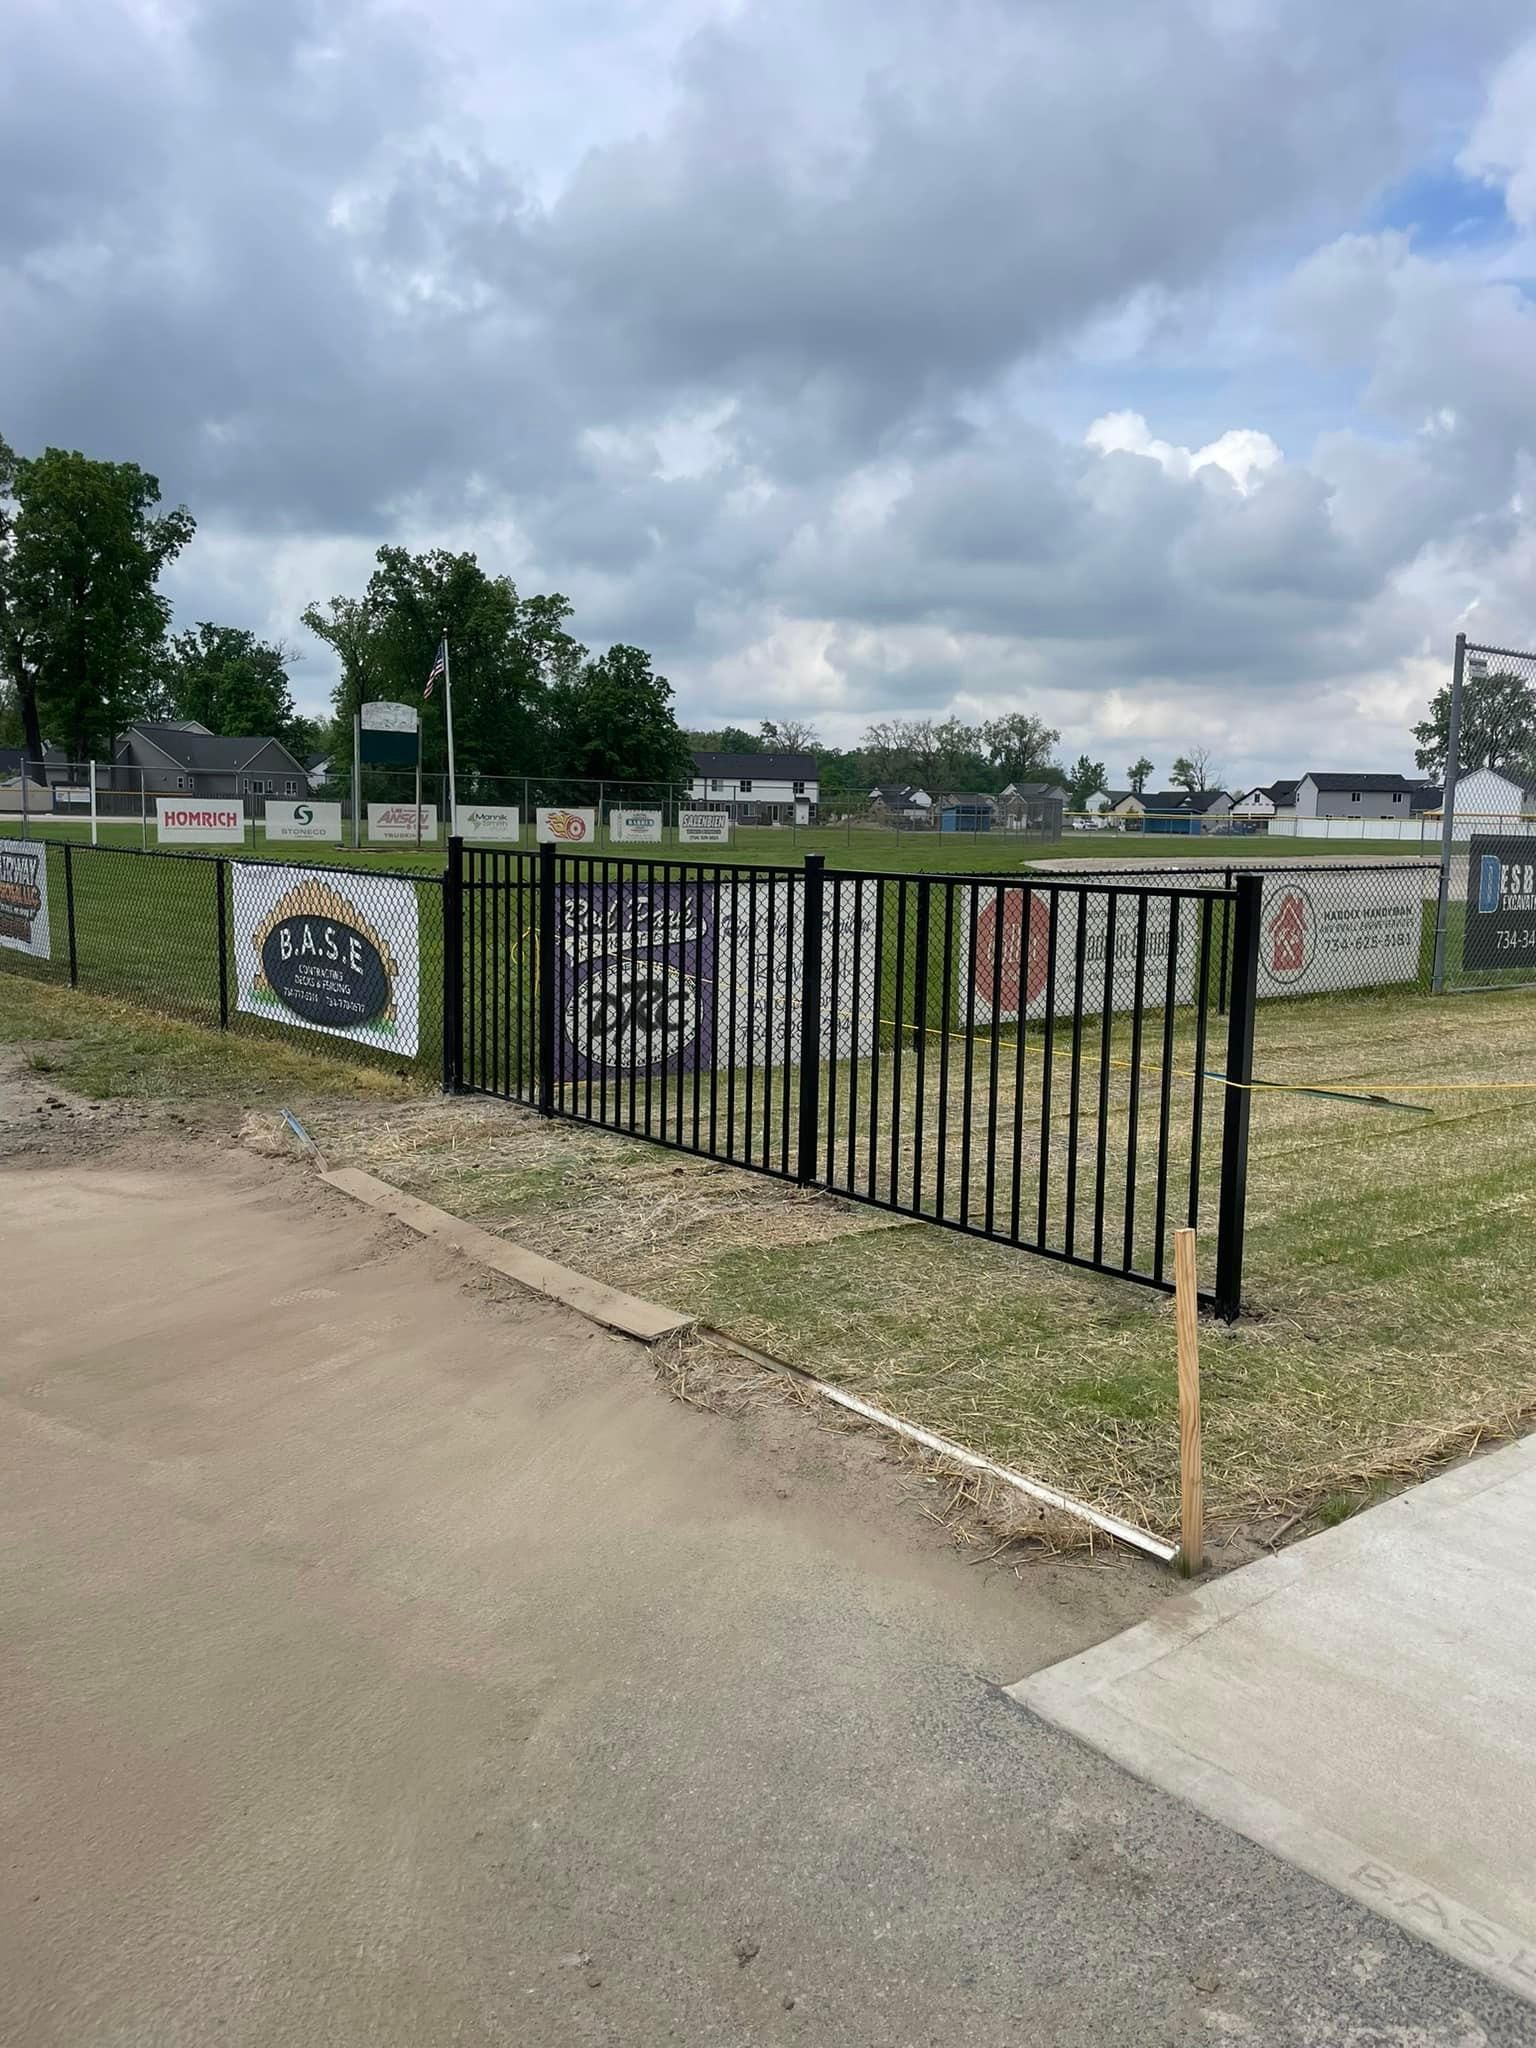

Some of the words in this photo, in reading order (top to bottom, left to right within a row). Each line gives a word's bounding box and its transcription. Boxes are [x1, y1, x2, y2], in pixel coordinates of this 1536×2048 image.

[164, 811, 237, 827] HOMRICH
[475, 812, 508, 821] Mannik
[682, 815, 726, 828] SALENBIEN
[281, 828, 327, 836] STONECO
